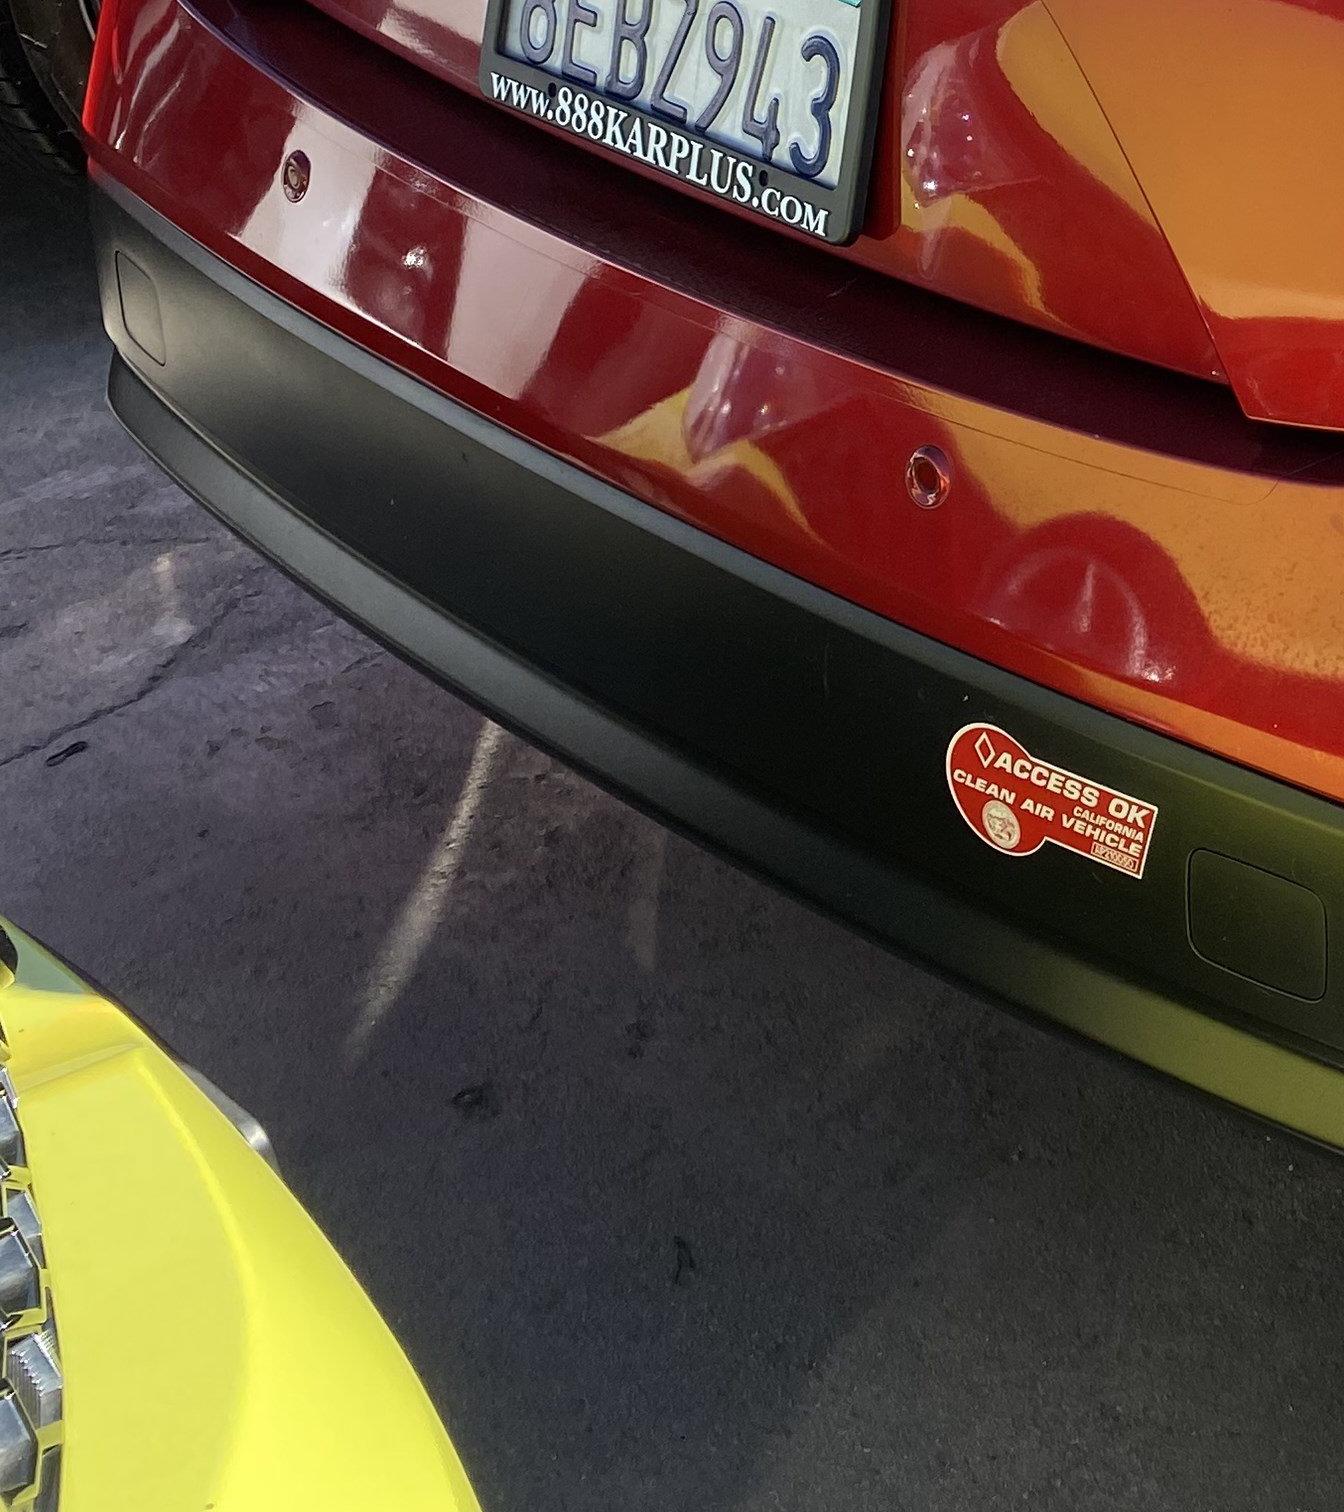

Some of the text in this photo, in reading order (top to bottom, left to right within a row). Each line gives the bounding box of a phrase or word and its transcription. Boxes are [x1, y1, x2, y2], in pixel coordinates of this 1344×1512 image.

[953, 769, 1016, 805] CLEAN
[1020, 798, 1055, 822] AIR
[1061, 814, 1143, 858] VEHICLE
[993, 752, 1151, 829] ACCESS OK
[1073, 805, 1144, 843] CALIFORNIA
